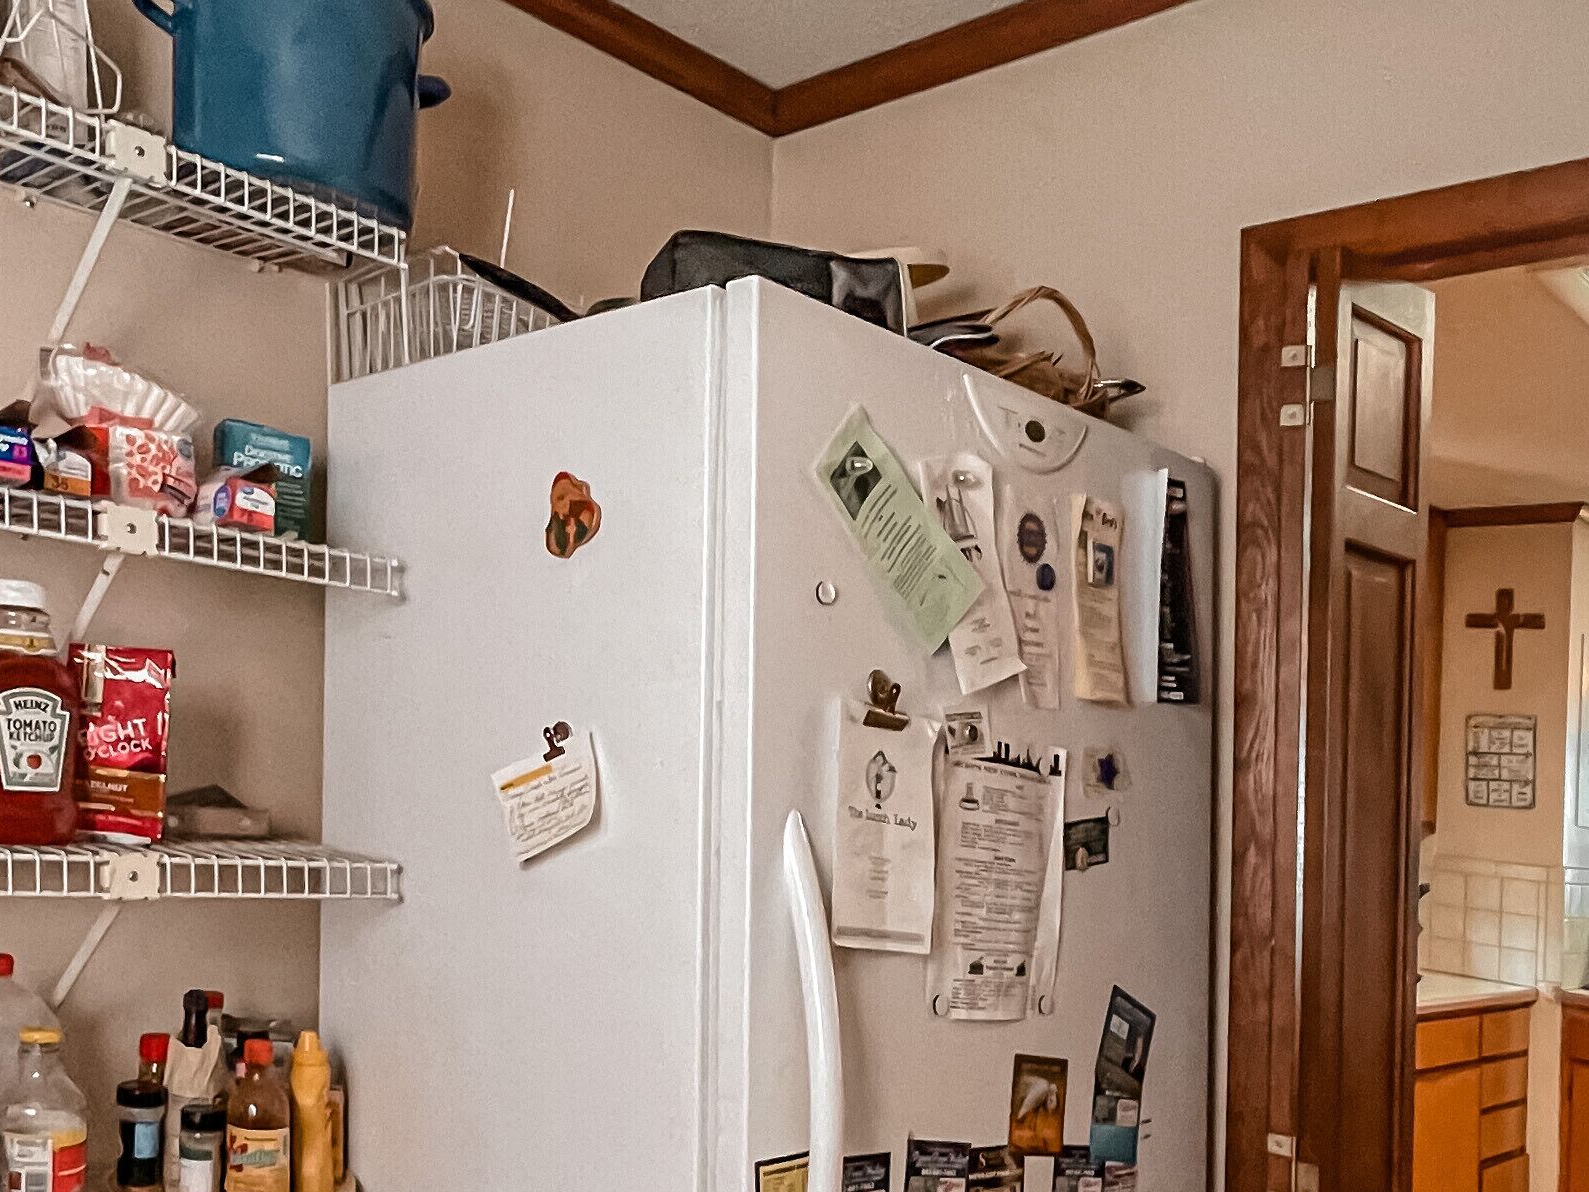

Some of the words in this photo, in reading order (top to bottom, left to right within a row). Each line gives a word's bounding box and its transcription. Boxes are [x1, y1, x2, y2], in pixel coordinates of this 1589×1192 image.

[13, 699, 50, 714] HEINZ
[6, 717, 57, 733] TOMATO
[9, 730, 56, 743] KETCHUP
